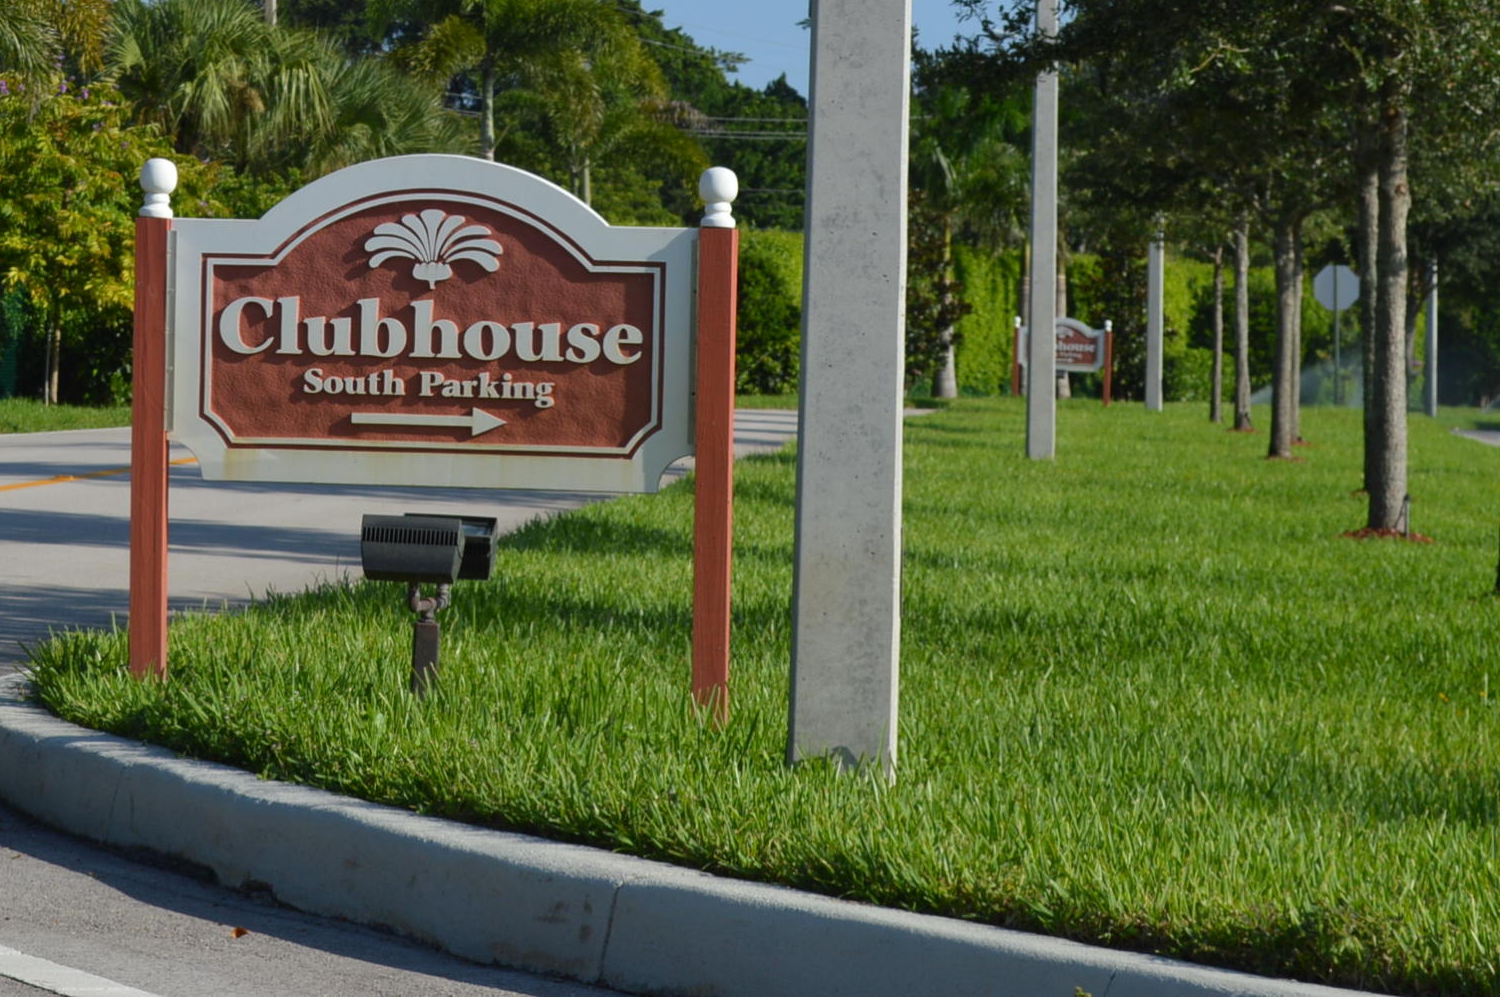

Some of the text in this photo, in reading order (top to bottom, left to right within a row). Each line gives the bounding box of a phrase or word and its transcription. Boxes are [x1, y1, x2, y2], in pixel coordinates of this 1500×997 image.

[219, 296, 643, 364] Clubhouse
[303, 367, 555, 408] South Parking
